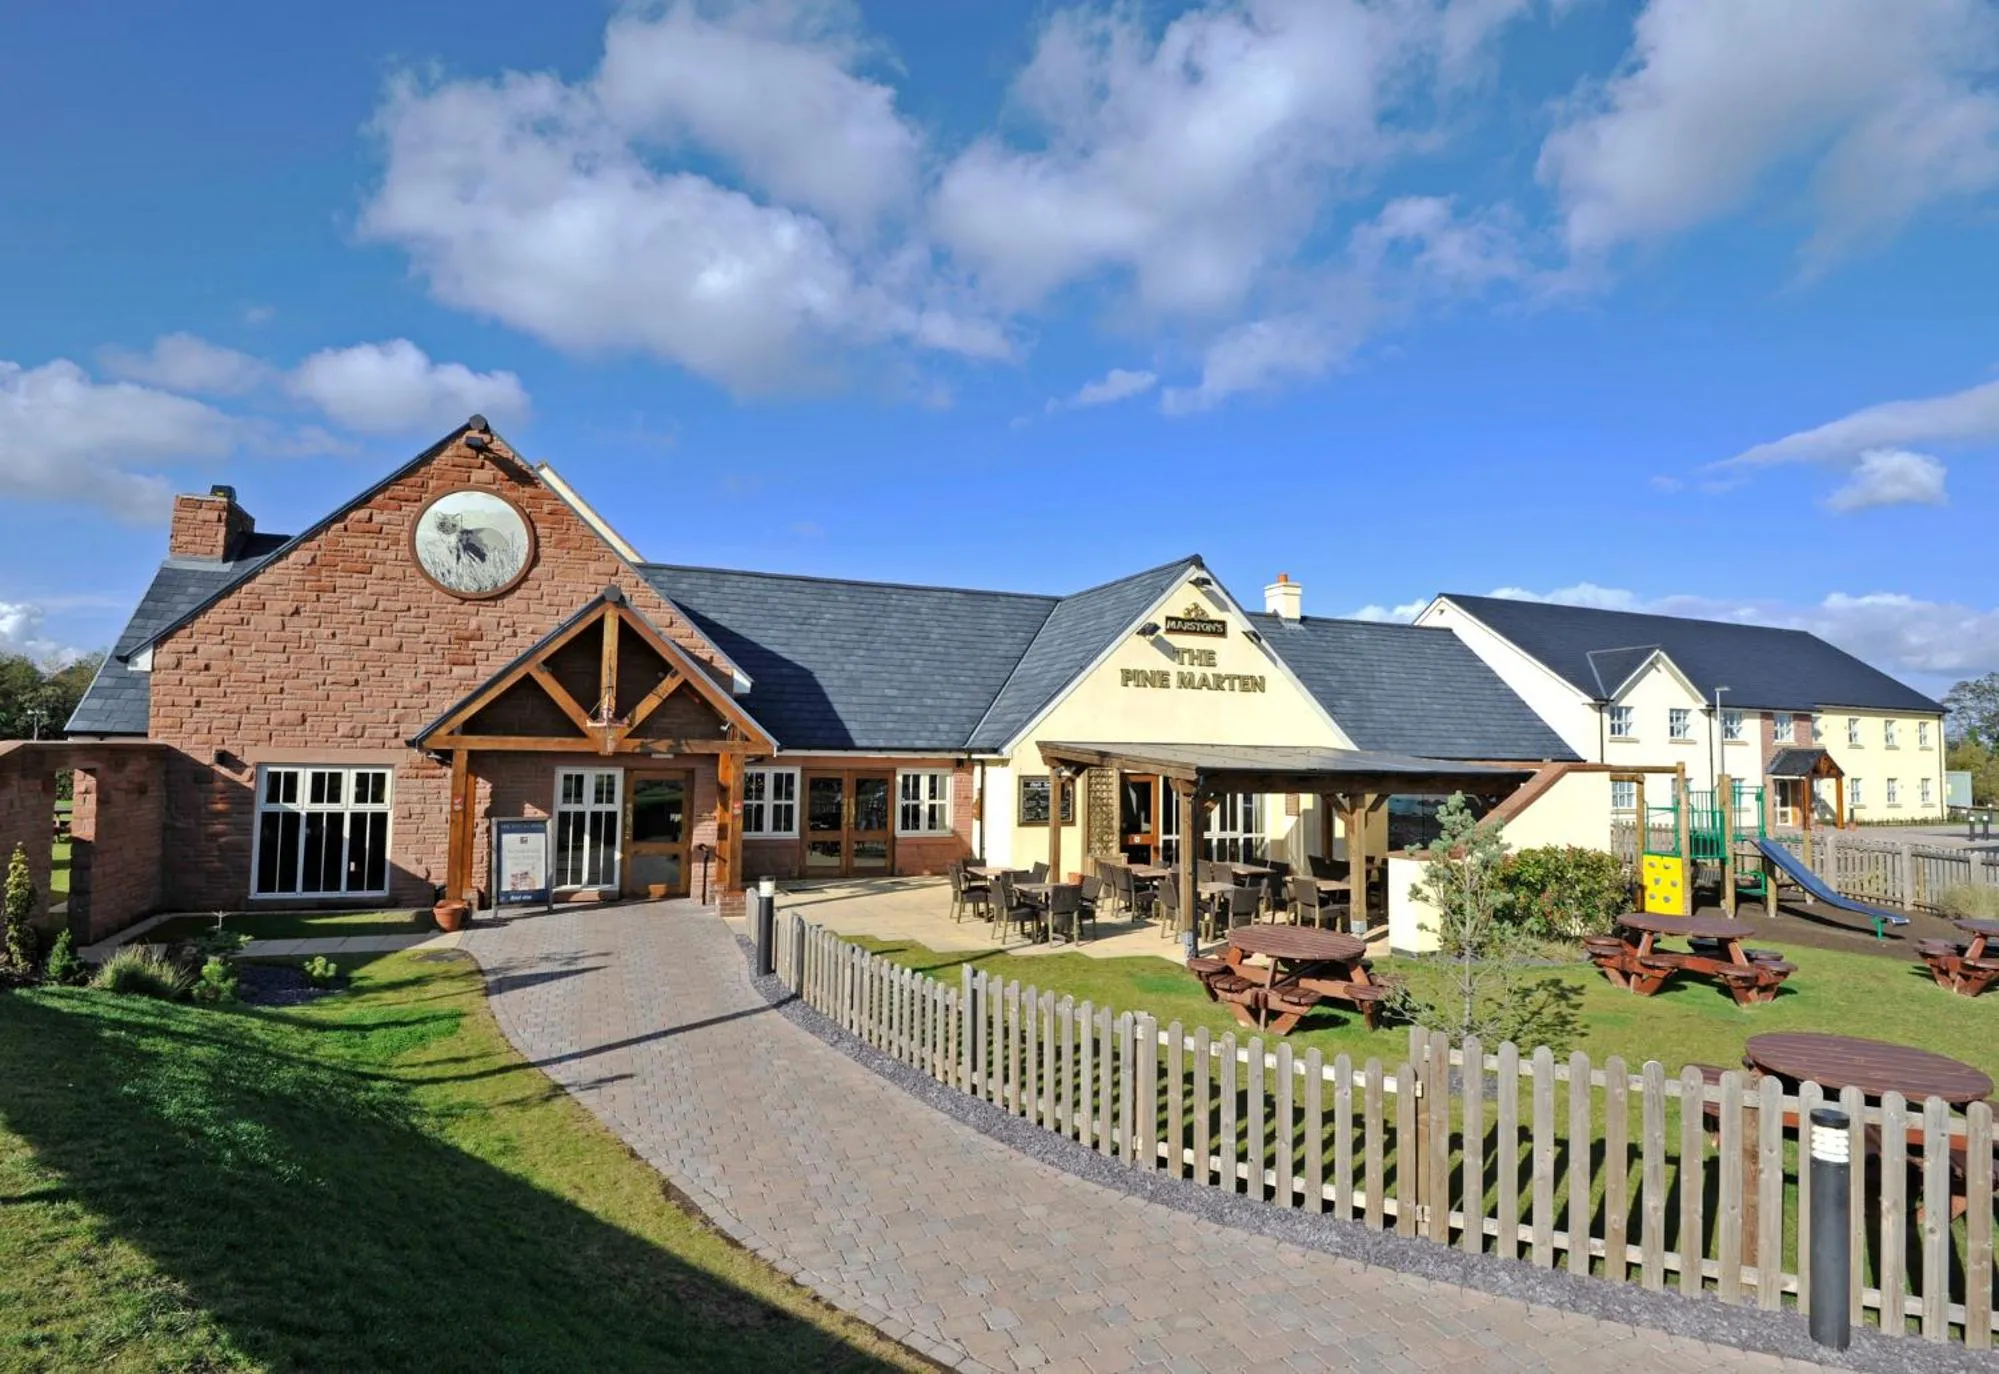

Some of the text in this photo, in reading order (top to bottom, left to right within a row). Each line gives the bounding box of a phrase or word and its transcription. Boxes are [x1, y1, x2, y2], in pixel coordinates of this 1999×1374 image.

[1166, 620, 1223, 633] MARSTON'S
[1174, 648, 1217, 667] THE
[1120, 669, 1265, 693] PINE MARTEN
